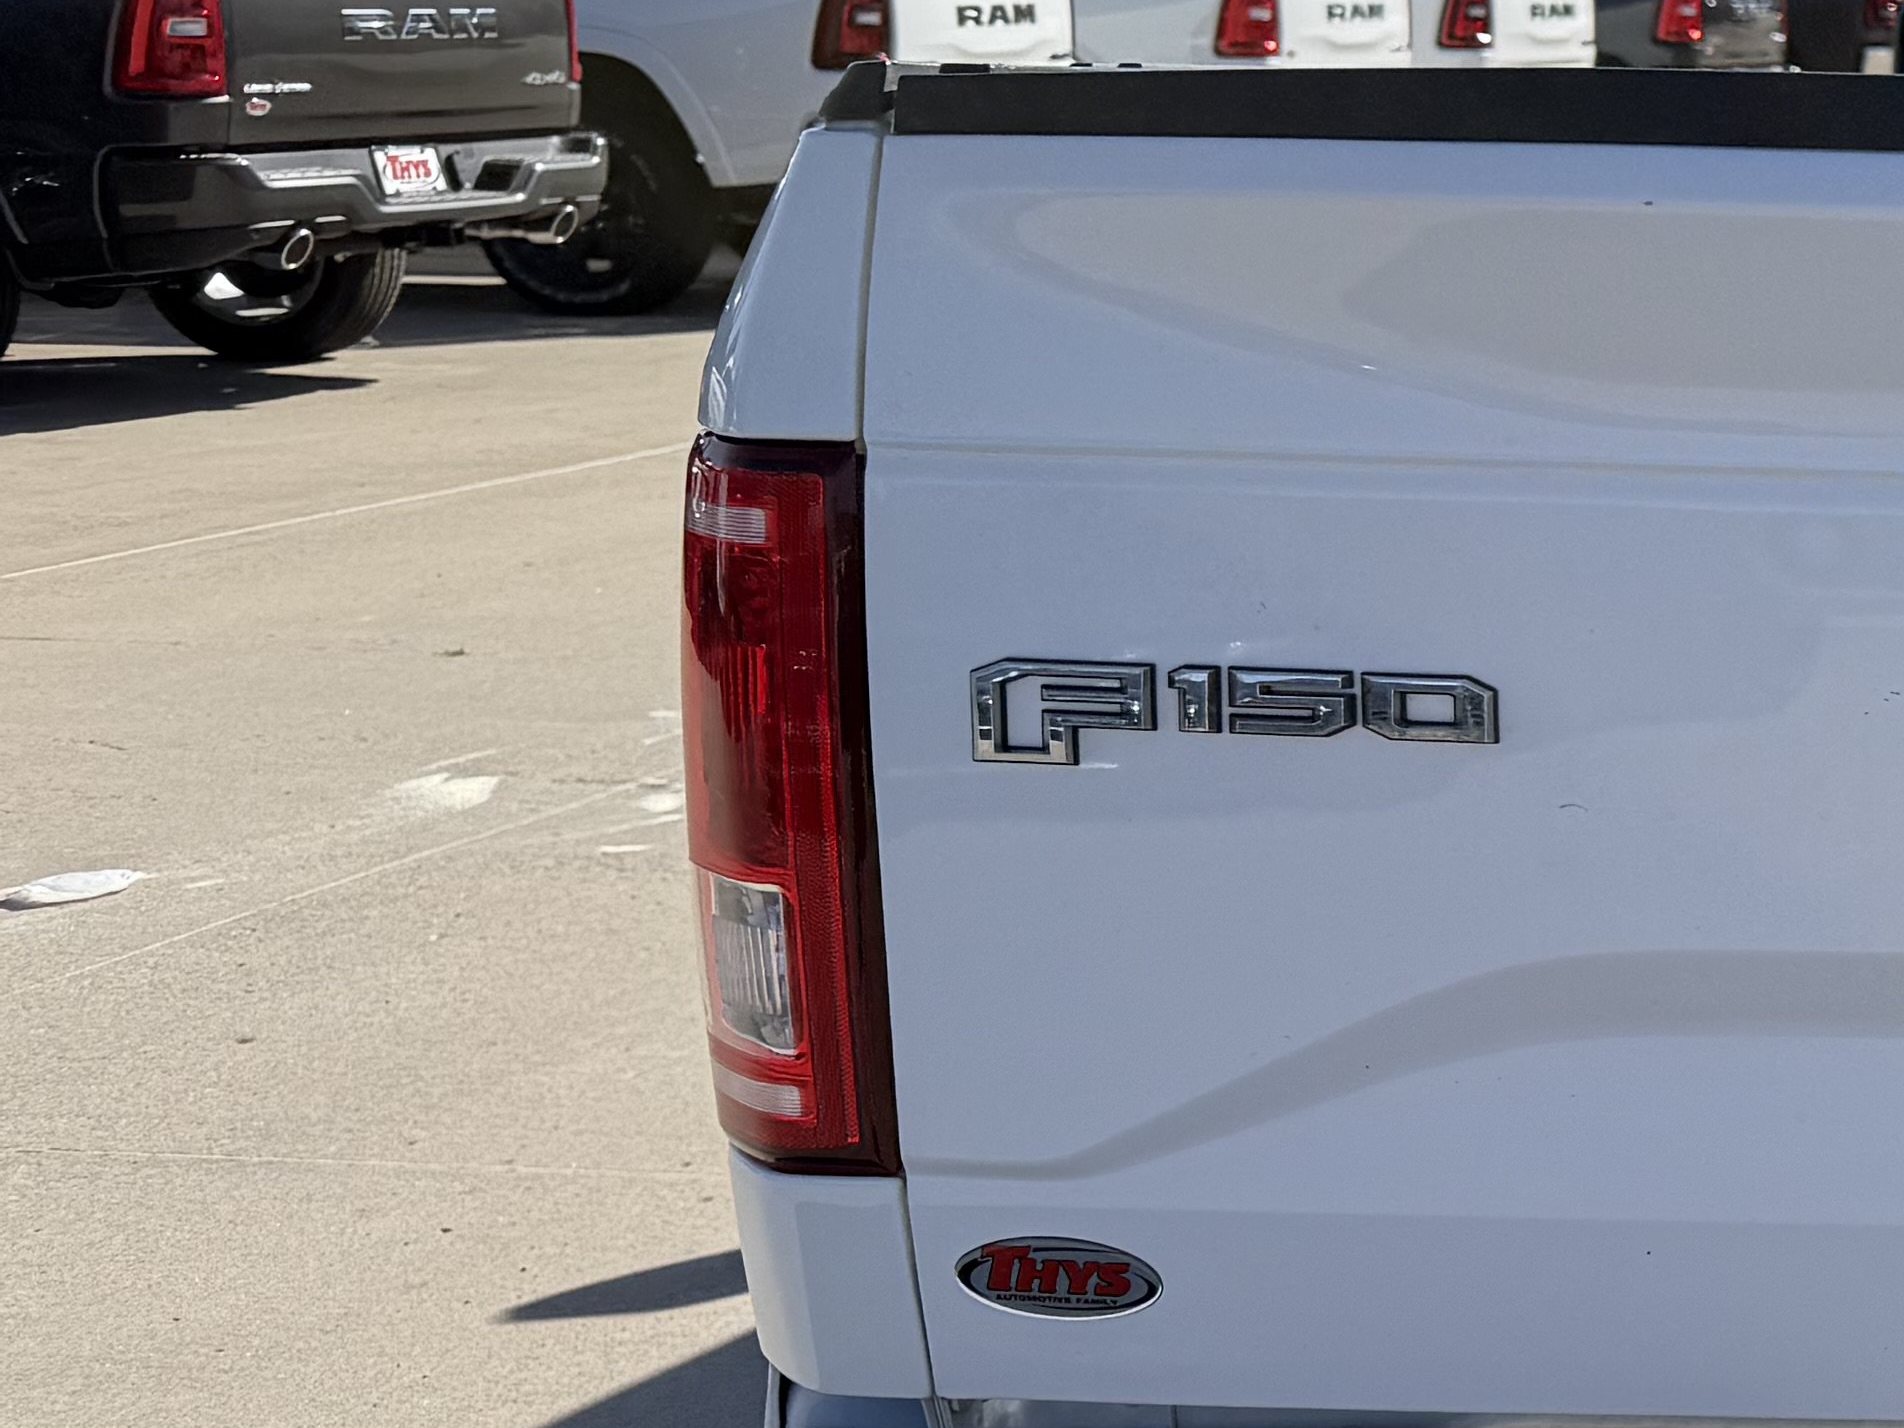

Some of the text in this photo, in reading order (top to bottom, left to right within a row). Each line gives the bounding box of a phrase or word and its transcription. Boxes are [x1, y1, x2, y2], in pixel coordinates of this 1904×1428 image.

[341, 8, 498, 40] RAM
[956, 3, 1036, 27] RAM
[1327, 3, 1384, 22] RAM
[981, 1244, 1132, 1297] THYS
